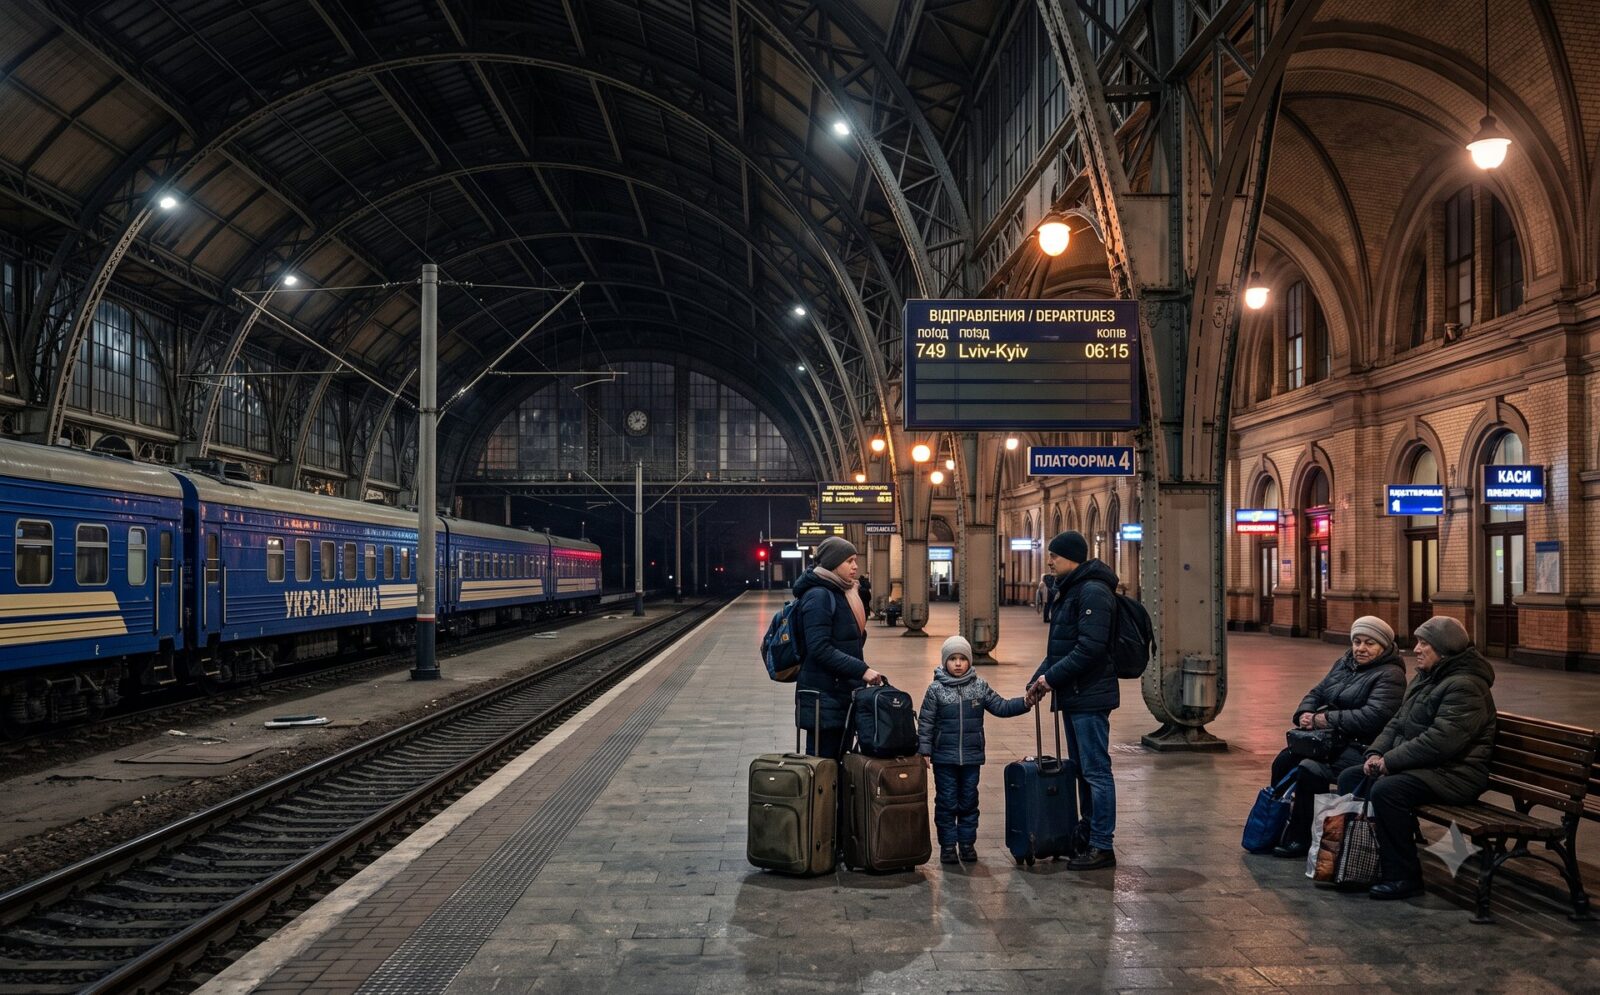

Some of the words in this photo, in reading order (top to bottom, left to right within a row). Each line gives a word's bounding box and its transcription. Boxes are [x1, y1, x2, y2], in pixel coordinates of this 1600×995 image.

[929, 309, 1025, 325] ВІДПРАВЛЕНИЯ
[1028, 309, 1035, 323] /
[915, 342, 946, 359] 749
[959, 342, 1029, 362] Lviv-Kyiv
[1084, 342, 1129, 359] 06:15
[1034, 454, 1116, 468] ПЛАТФОРМА
[1118, 450, 1131, 471] 4
[1498, 470, 1532, 484] КАСИ
